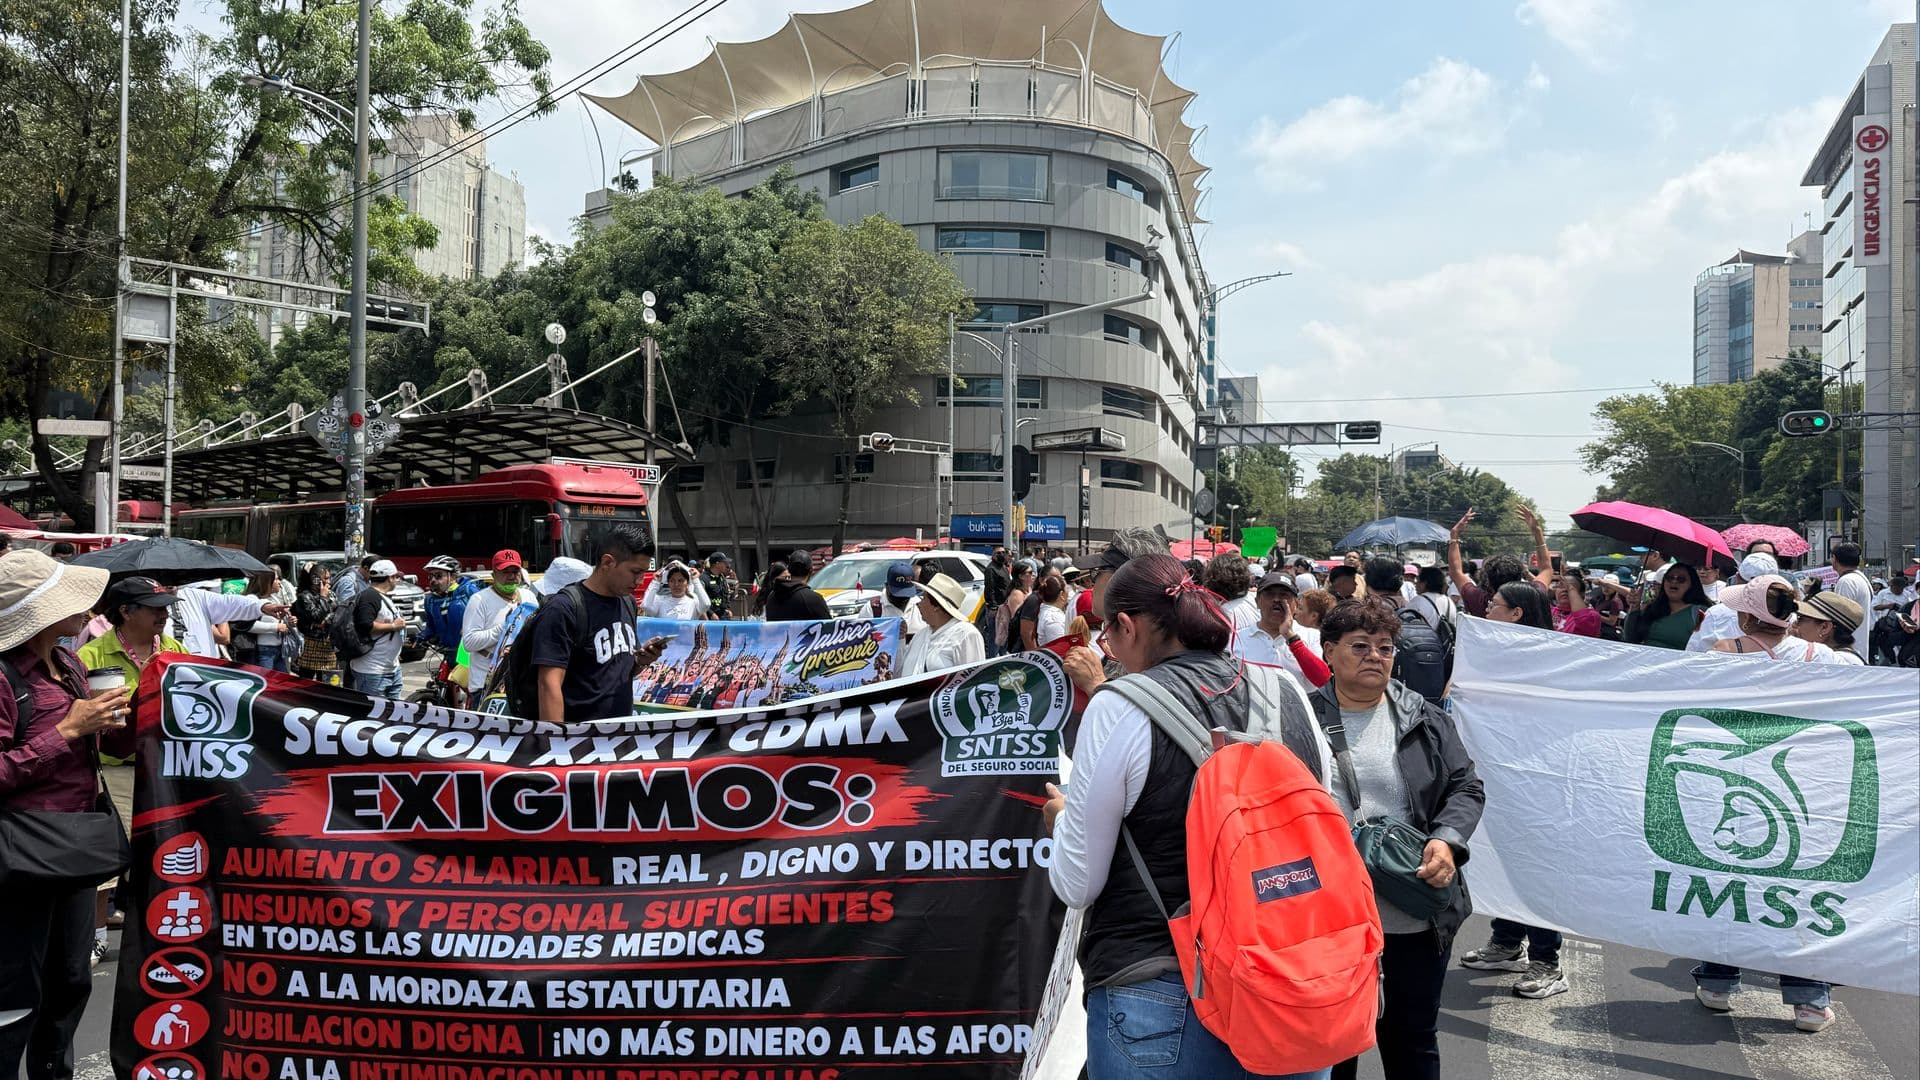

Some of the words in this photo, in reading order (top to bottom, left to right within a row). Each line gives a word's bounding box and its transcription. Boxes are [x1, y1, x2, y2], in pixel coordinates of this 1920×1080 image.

[1863, 157, 1880, 256] URGENCIAS
[968, 521, 987, 533] buk
[1026, 520, 1046, 533] buk
[795, 618, 872, 663] Jalisco
[801, 634, 877, 680] presente
[1028, 653, 1064, 710] TRABAJADORES
[284, 708, 524, 762] SECCION
[529, 729, 713, 767] XXXV
[728, 698, 910, 752] CDMX
[956, 733, 1048, 759] SNTSS
[162, 741, 254, 779] IMSS
[948, 762, 968, 773] DEL
[972, 760, 1016, 772] SEGURO
[1020, 761, 1059, 771] SOCIAL
[322, 763, 877, 835] EXIGIMOS:
[222, 846, 400, 884] AUMENTO
[409, 854, 601, 886] SALARIAL
[613, 855, 710, 886] REAL
[740, 843, 860, 879] DIGNO
[869, 842, 895, 871] Y
[905, 838, 1054, 871] DIRECTO
[1258, 868, 1313, 894] JANSPORT
[222, 893, 372, 928] INSUMOS
[384, 899, 412, 930] Y
[418, 901, 630, 933] PERSONAL
[643, 891, 895, 930] SUFICIENTES
[1651, 870, 1848, 936] IMSS
[222, 925, 255, 948] EN
[262, 926, 357, 954] TODAS
[364, 930, 421, 957] LAS
[430, 933, 603, 959] UNIDADES
[610, 929, 766, 957] MEDICAS
[222, 961, 277, 996] NO
[286, 971, 310, 997] A
[319, 973, 360, 1001] LA
[369, 975, 536, 1008] MORDAZA
[546, 978, 792, 1009] ESTATUTARIA
[223, 1008, 402, 1051] JUBILACION
[412, 1022, 524, 1055] DIGNA
[553, 1027, 610, 1057] ¡NO
[620, 1020, 695, 1056] MÁS
[705, 1026, 832, 1057] DINERO
[840, 1027, 865, 1056] A
[874, 1025, 938, 1056] LAS
[945, 1024, 1032, 1055] AFOR
[222, 1051, 269, 1080] NO
[280, 1057, 303, 1080] A
[306, 1058, 341, 1080] LA
